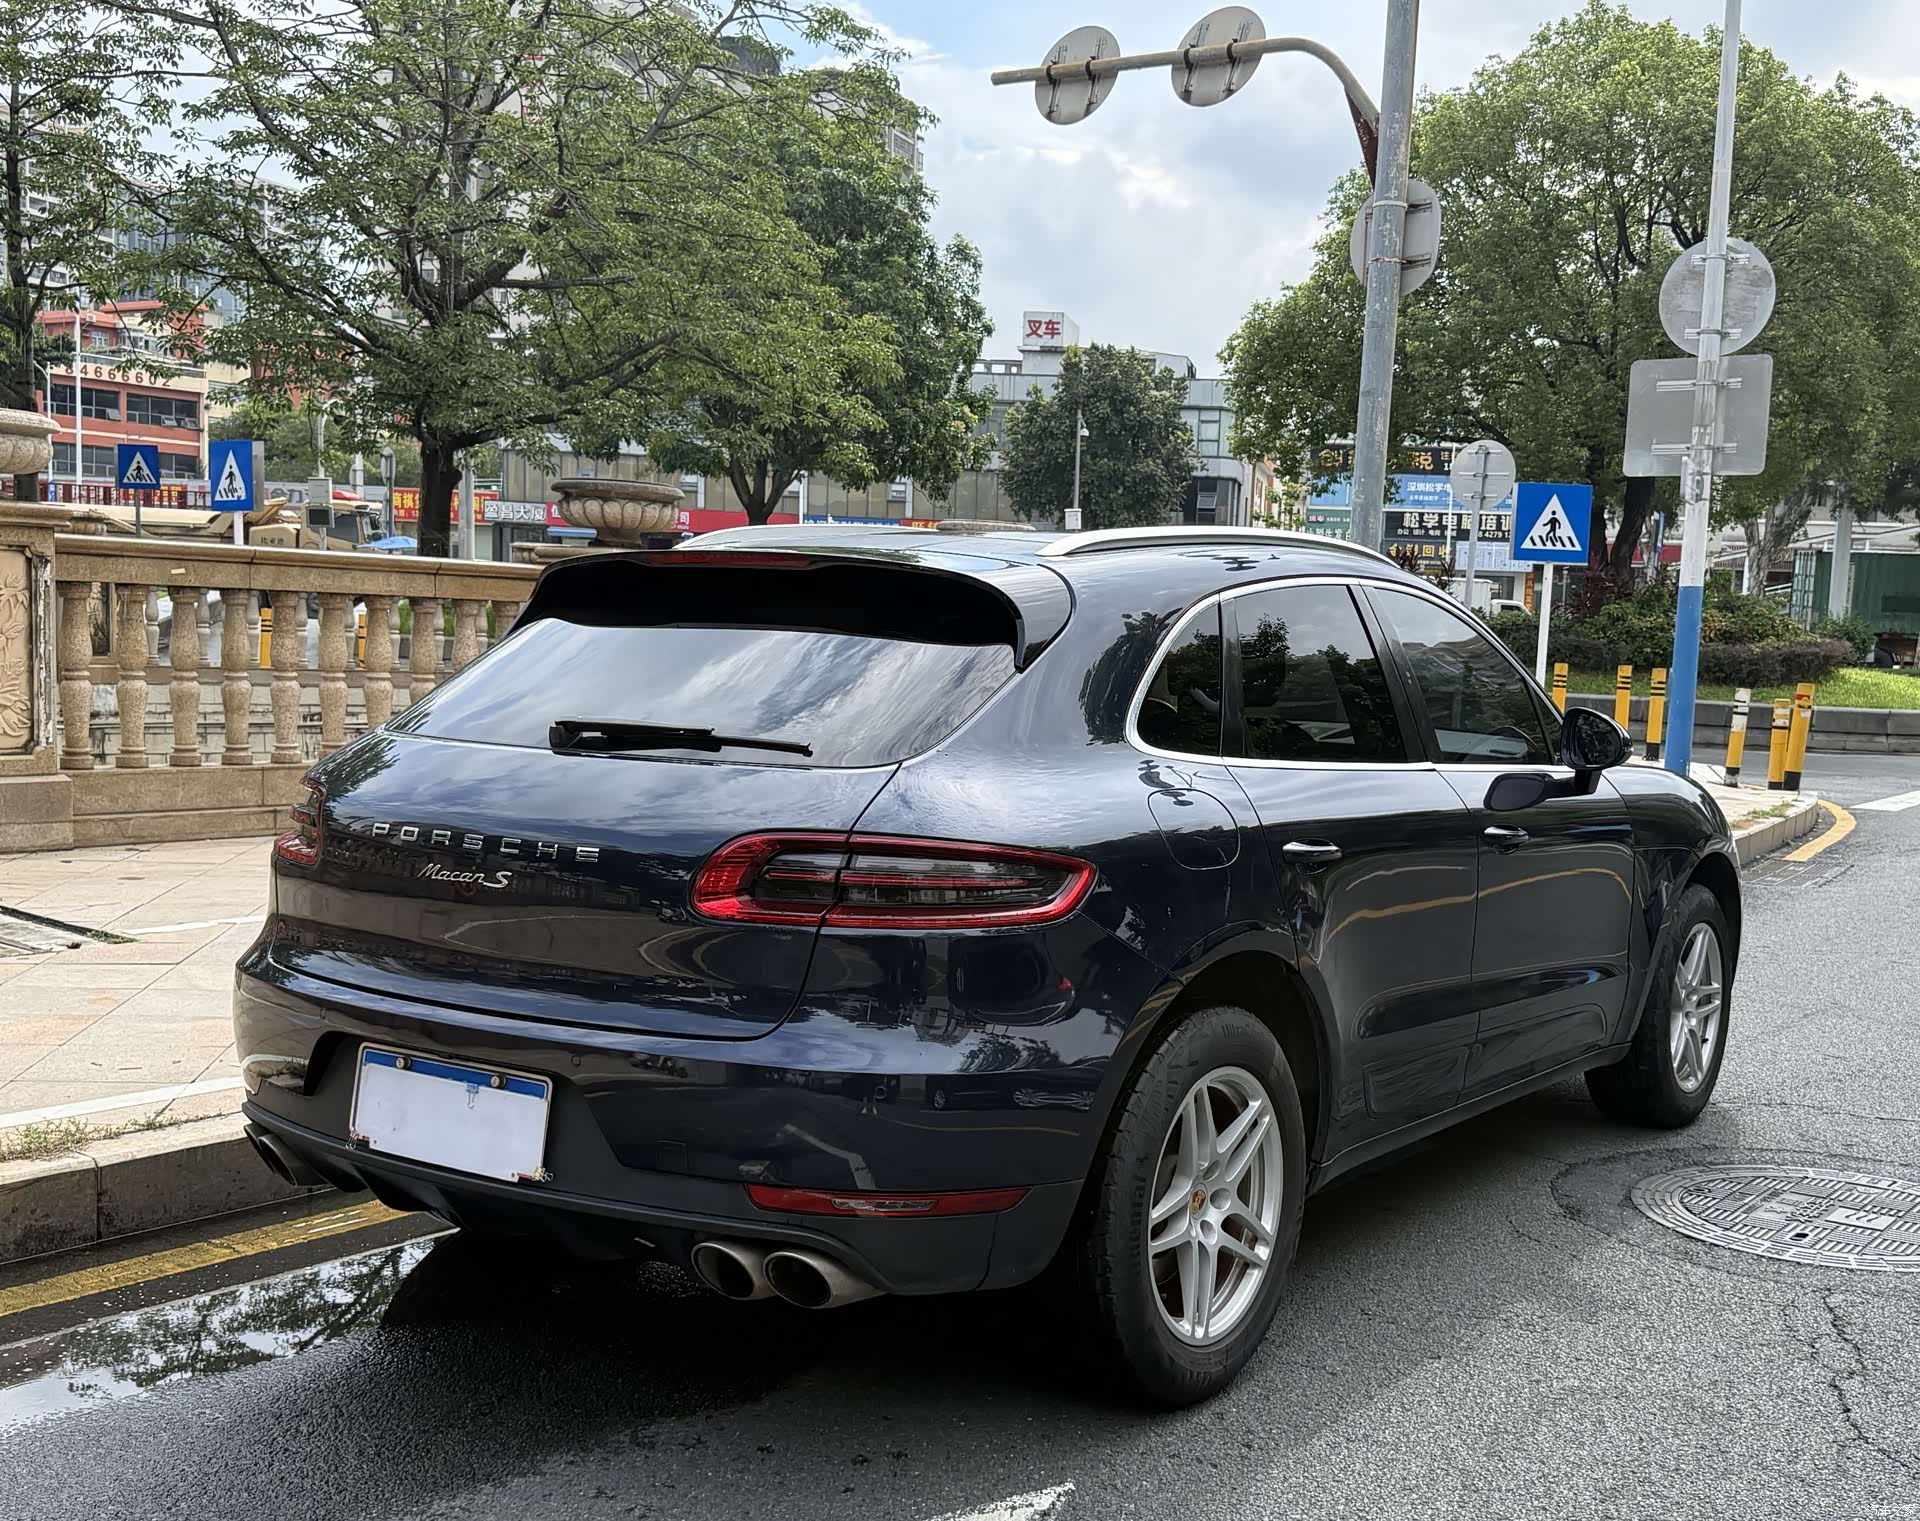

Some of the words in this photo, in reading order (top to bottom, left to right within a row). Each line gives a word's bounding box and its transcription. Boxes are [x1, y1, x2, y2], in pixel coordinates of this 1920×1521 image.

[1026, 319, 1061, 339] 叉车
[485, 504, 546, 521] 盈昌大厦
[372, 822, 600, 863] PORSCHE
[417, 863, 485, 884] Macan
[482, 871, 513, 888] S
